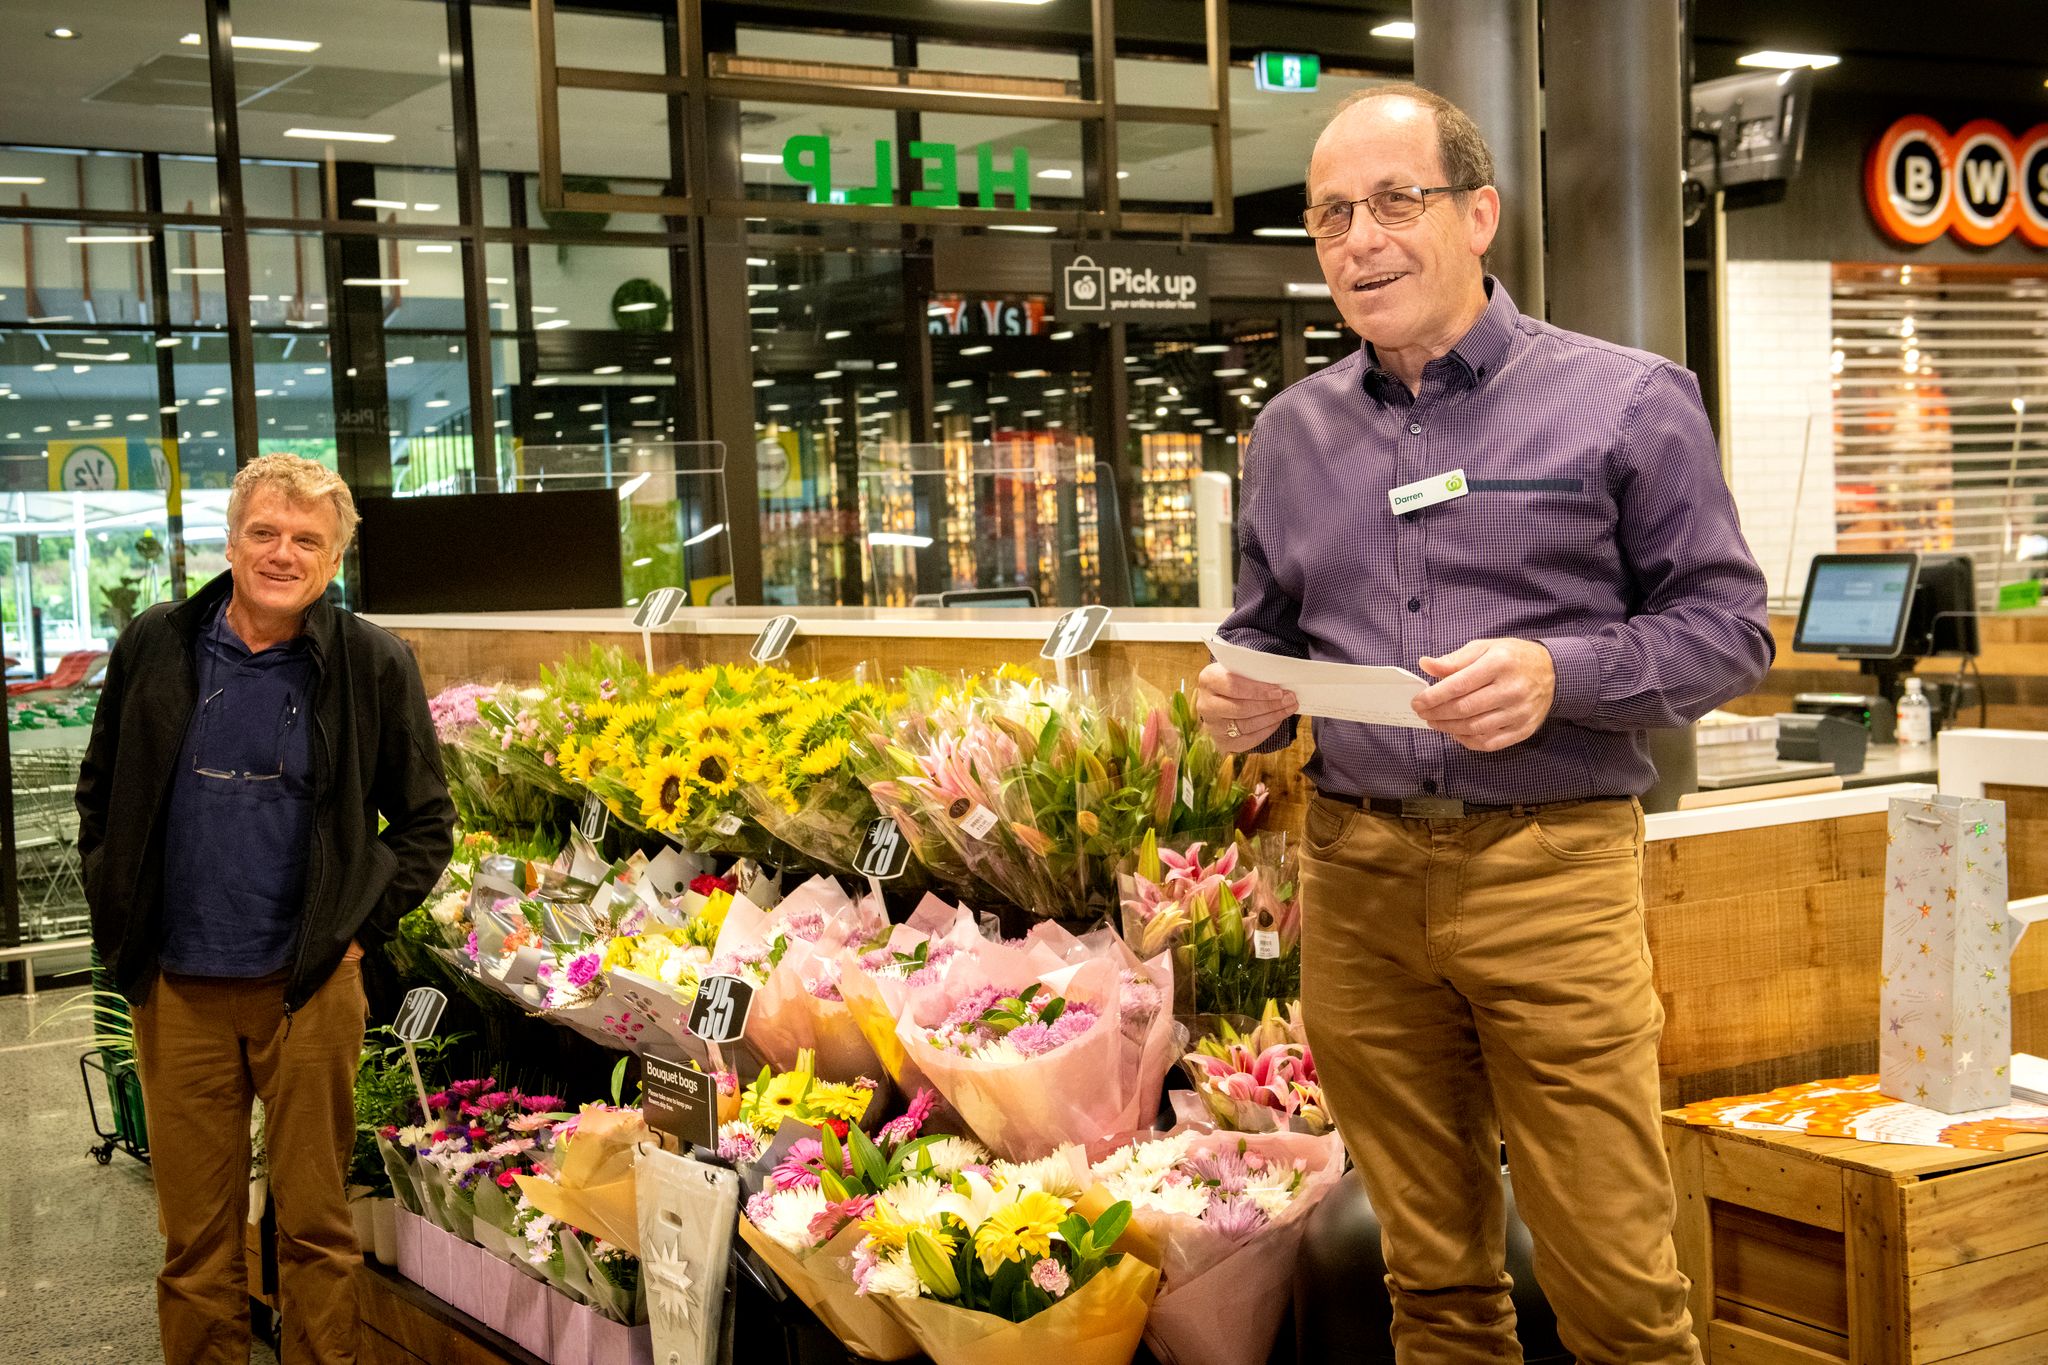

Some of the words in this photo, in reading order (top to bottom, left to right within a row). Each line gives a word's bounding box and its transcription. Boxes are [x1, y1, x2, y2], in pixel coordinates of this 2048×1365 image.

[1109, 266, 1161, 294] Pick
[1164, 274, 1197, 301] up
[1394, 491, 1424, 506] Darren
[697, 976, 742, 1041] $35
[647, 1061, 678, 1084] Bouquet
[679, 1072, 698, 1094] bags
